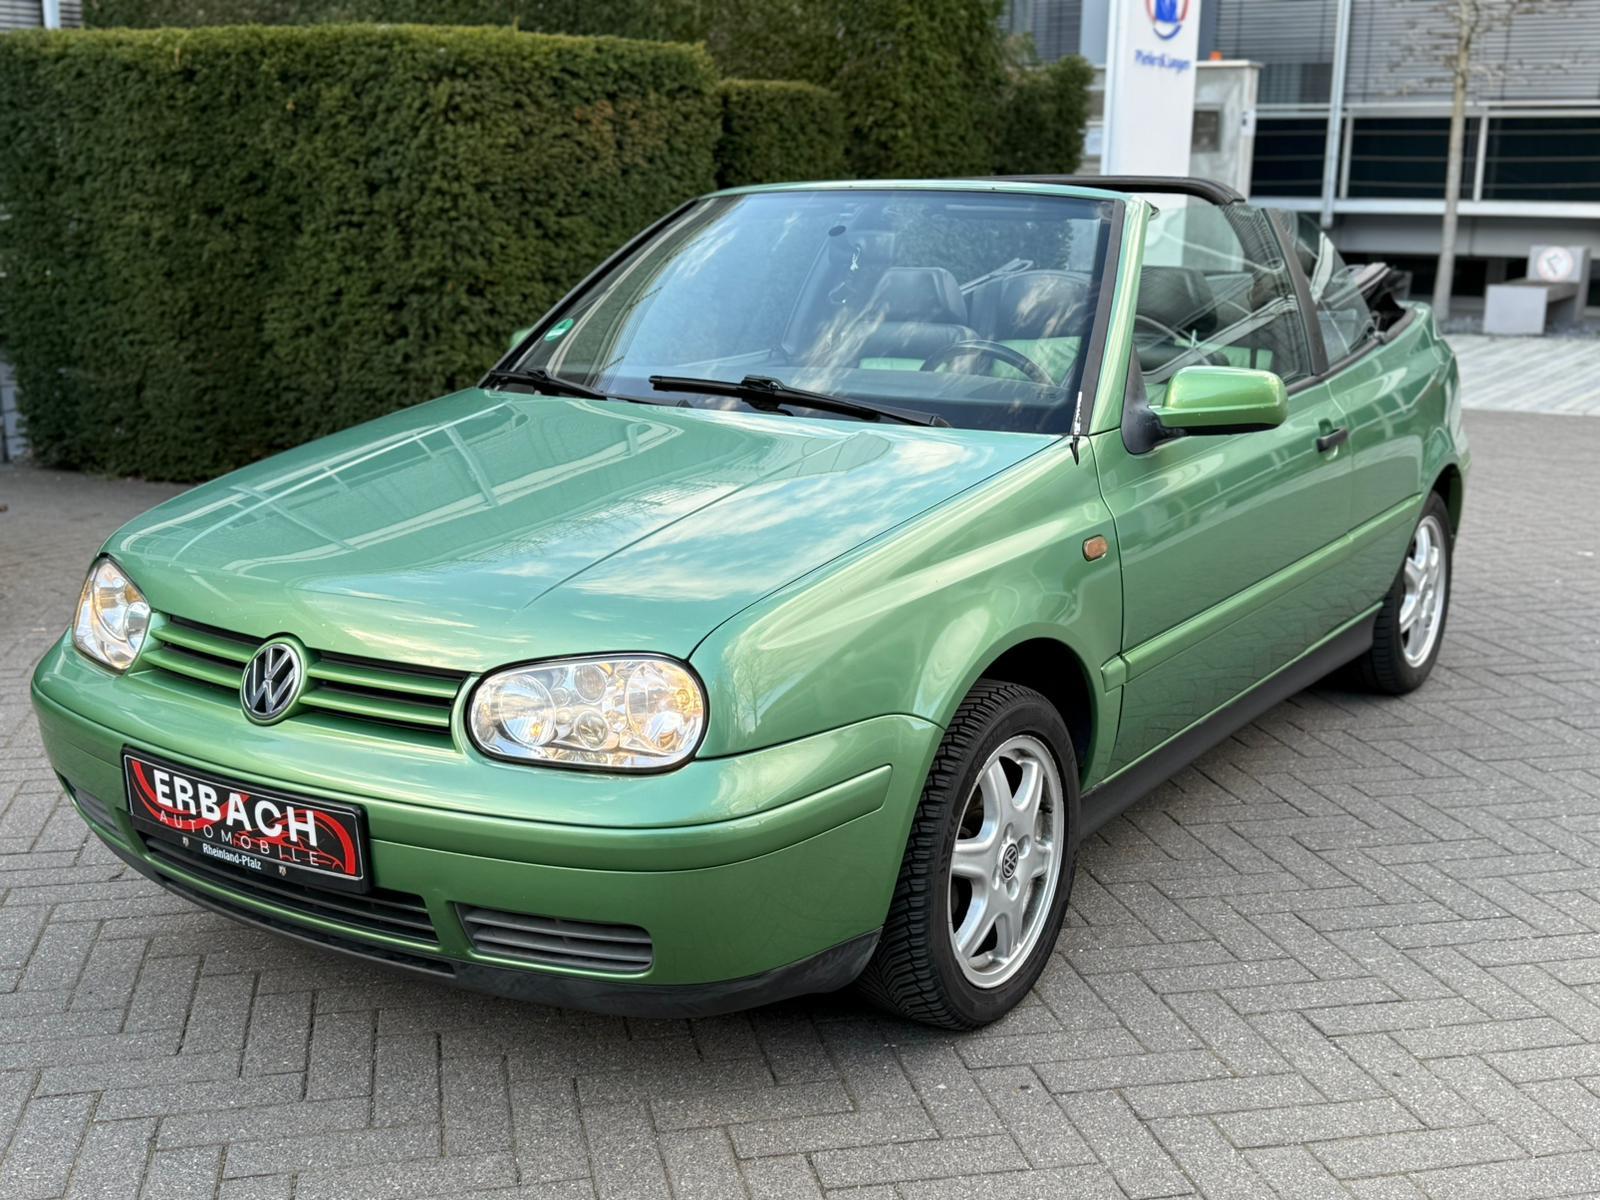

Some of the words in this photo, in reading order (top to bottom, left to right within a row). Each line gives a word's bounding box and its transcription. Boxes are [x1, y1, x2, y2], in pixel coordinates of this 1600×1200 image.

[153, 769, 318, 847] ERBACH
[159, 810, 320, 867] AUTOMOBILE
[202, 842, 262, 871] Rheinland-Pfalz
